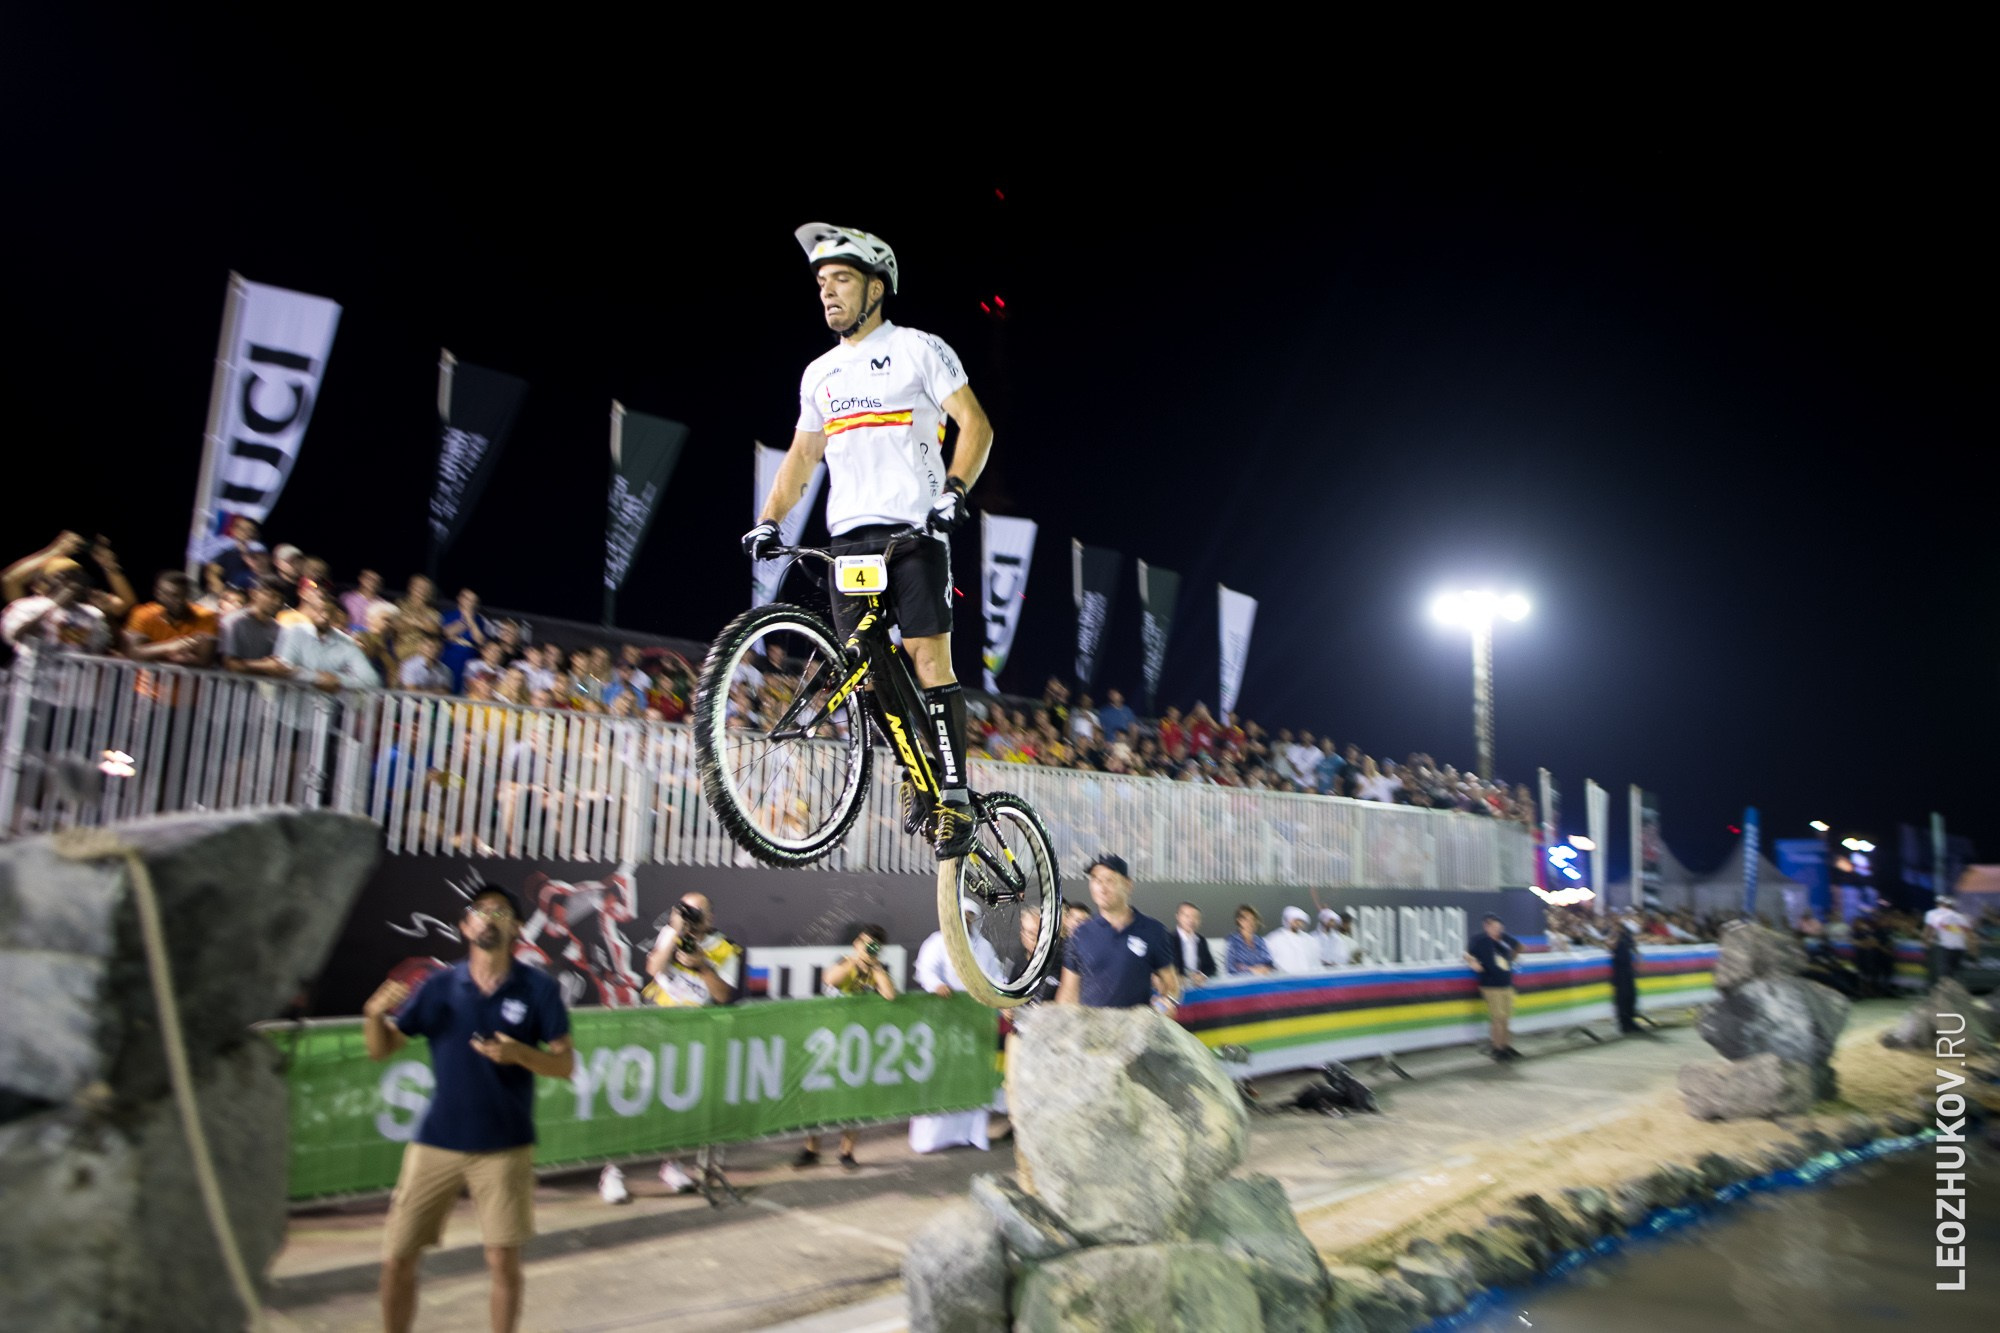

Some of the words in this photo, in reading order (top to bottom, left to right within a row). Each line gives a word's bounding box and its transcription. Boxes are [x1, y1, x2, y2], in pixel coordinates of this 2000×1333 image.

[220, 344, 316, 504] UCI
[830, 397, 882, 413] Cofidis
[855, 570, 866, 586] 4
[885, 712, 928, 792] CLEAN
[573, 1042, 706, 1121] YOU
[725, 1035, 786, 1105] IN
[801, 1022, 936, 1092] 2023
